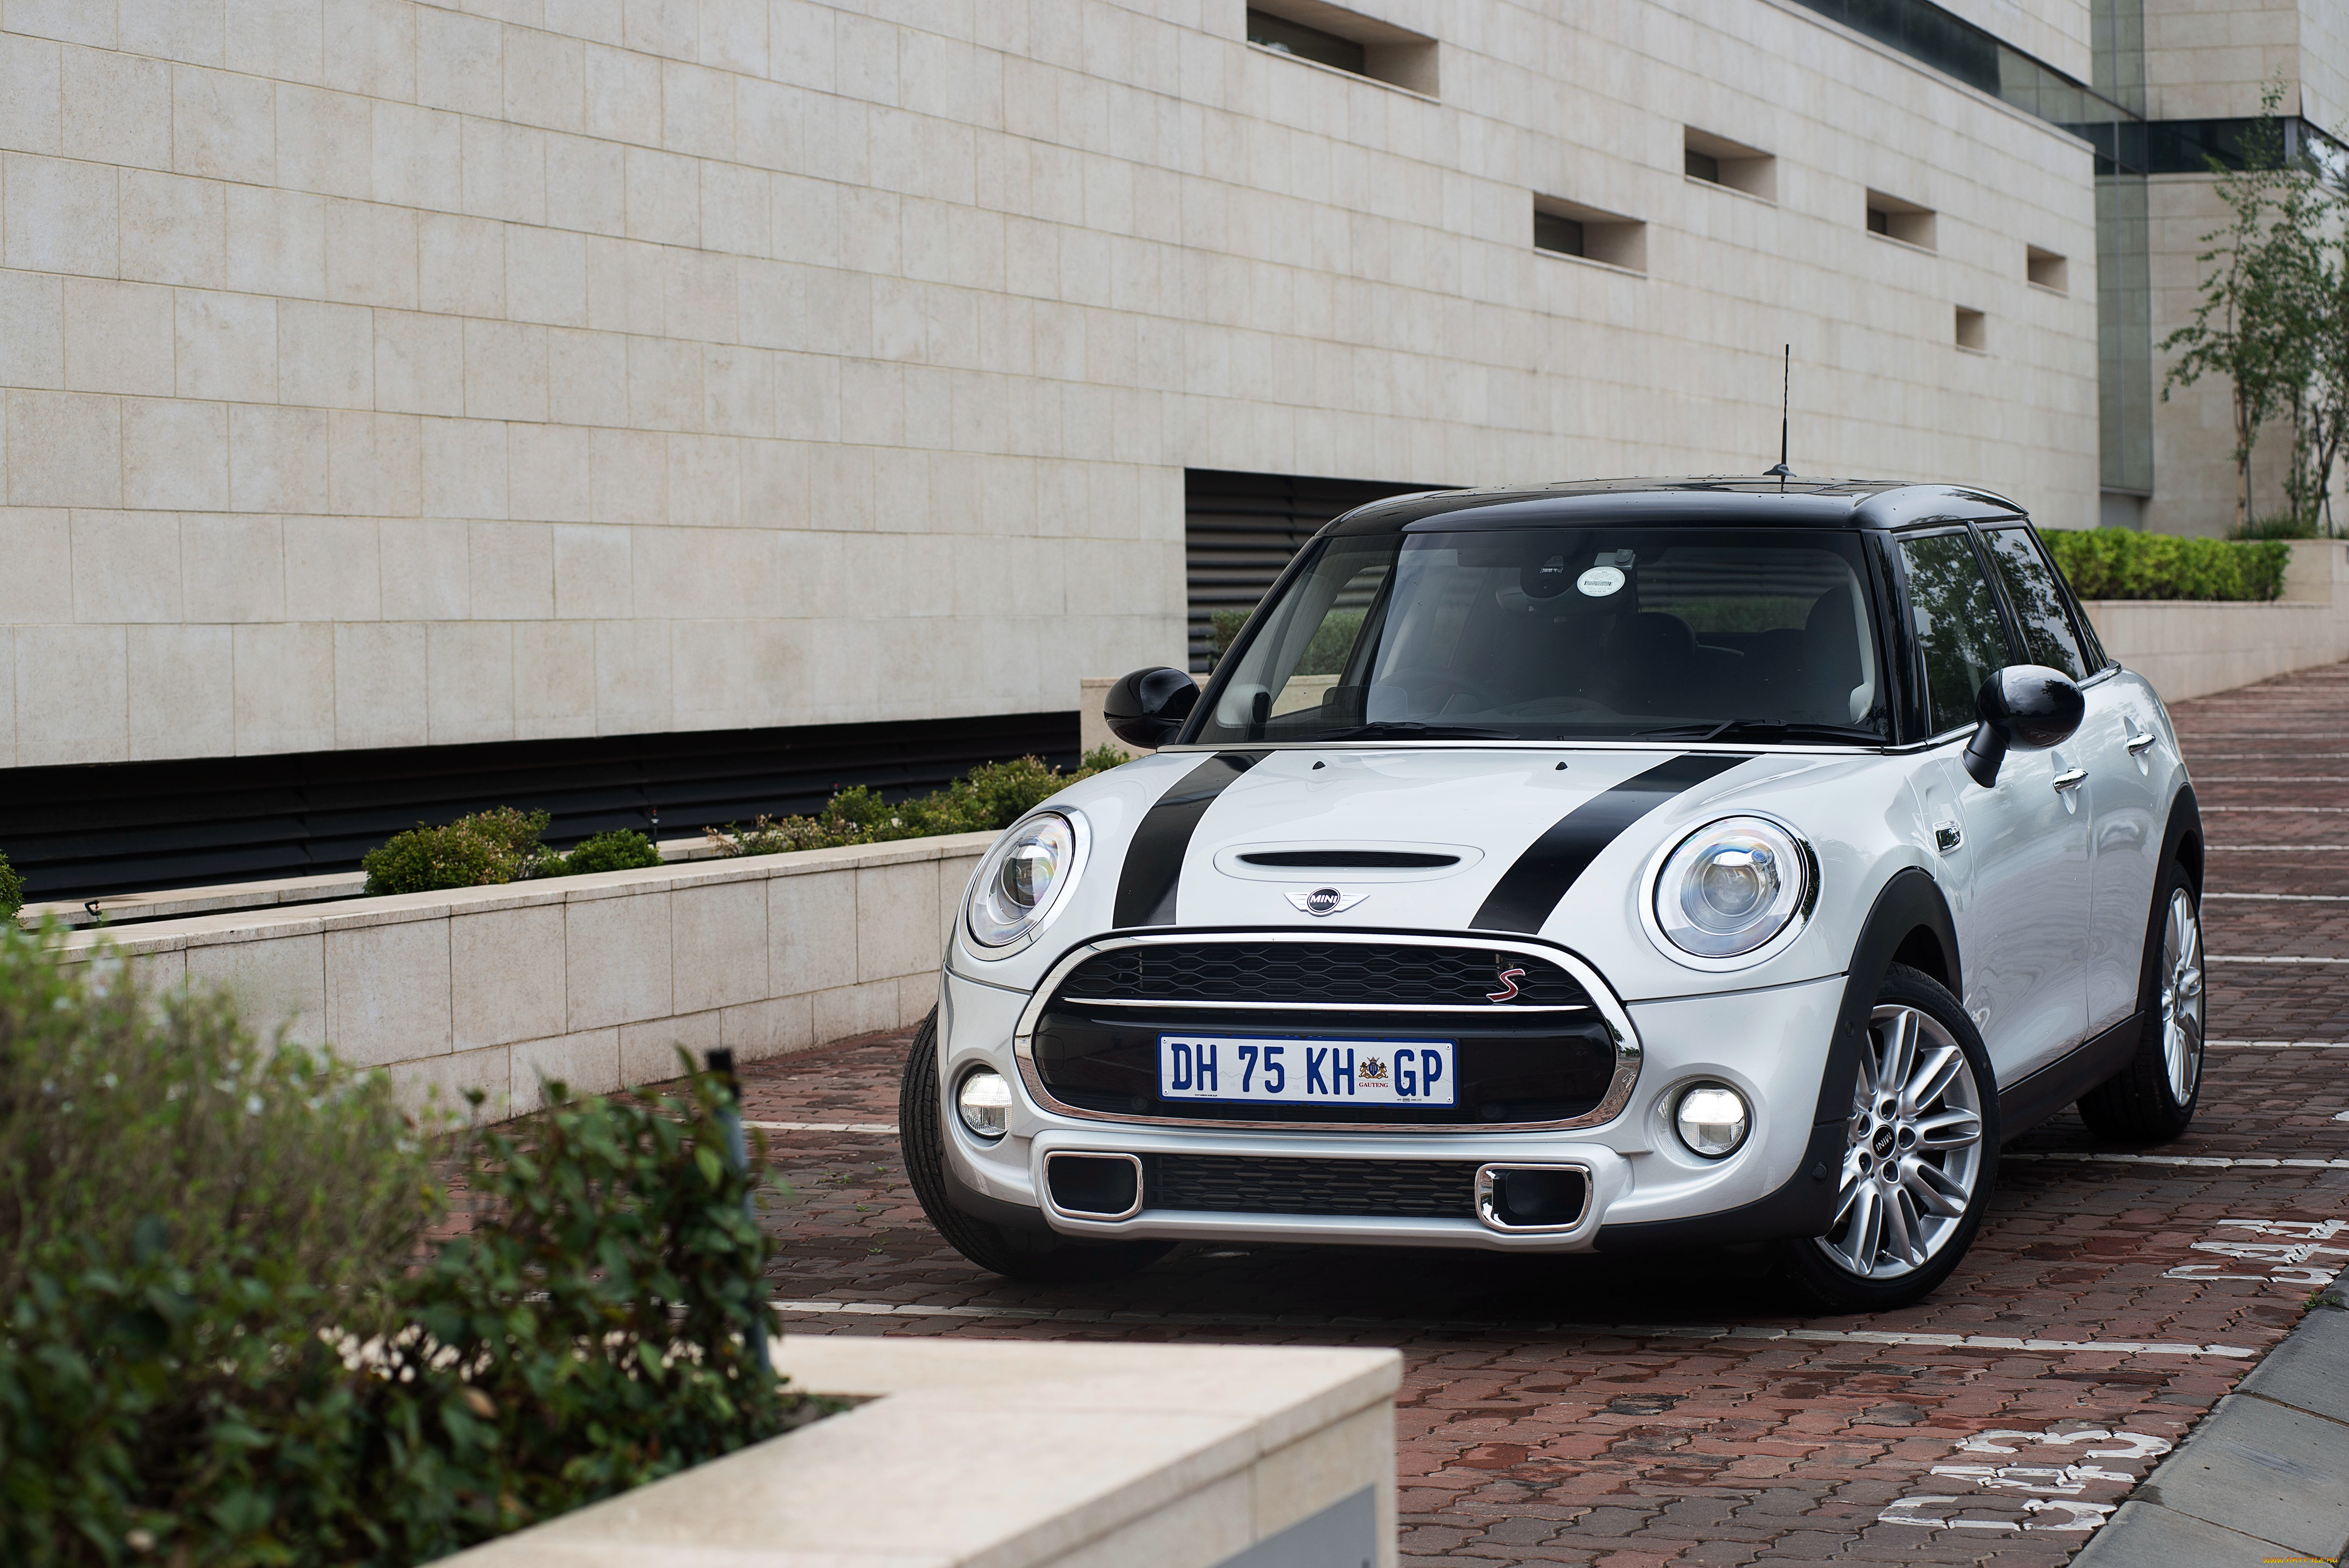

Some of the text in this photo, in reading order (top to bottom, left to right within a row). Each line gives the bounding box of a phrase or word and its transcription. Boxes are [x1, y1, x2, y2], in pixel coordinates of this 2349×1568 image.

[1310, 895, 1337, 903] MINI
[1486, 968, 1525, 1003] S
[1171, 1043, 1442, 1097] DH 75 KH GP
[1875, 1132, 1893, 1152] MINI
